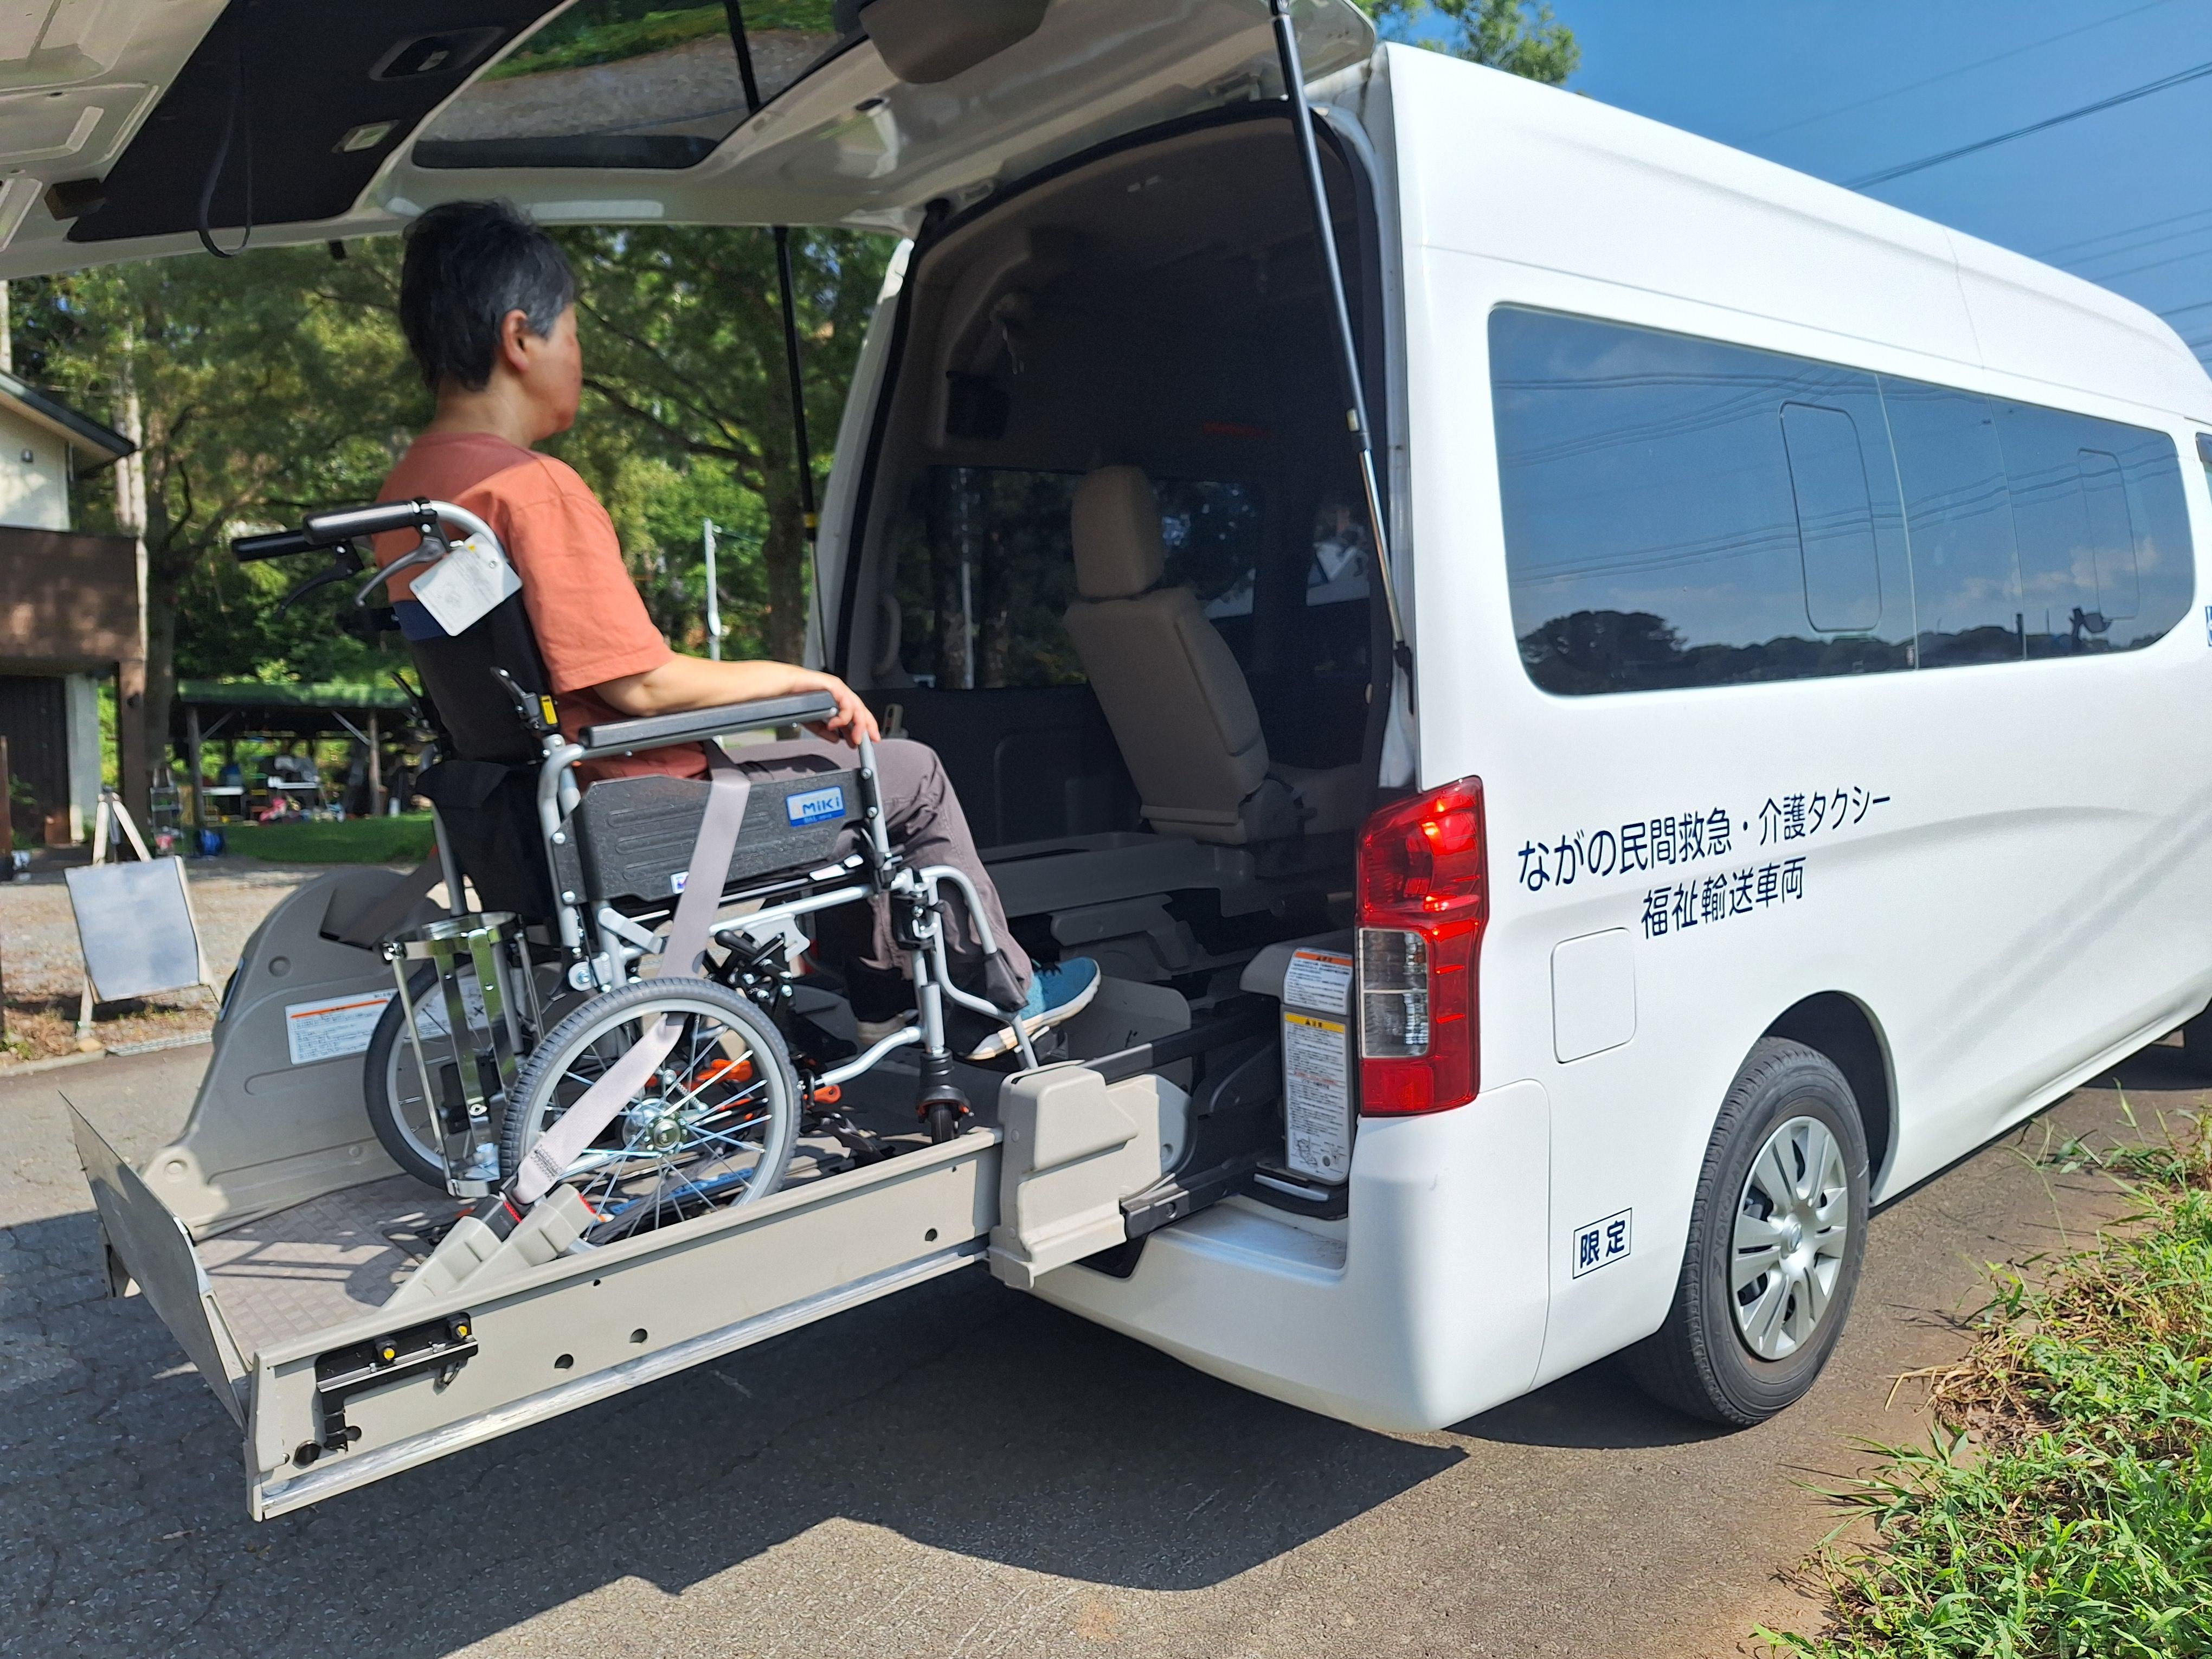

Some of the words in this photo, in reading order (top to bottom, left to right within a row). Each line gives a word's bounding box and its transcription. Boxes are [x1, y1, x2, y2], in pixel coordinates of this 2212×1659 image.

[1519, 786, 1891, 891] ながの民間救急・介護タクシー
[1641, 857, 1806, 939] 福祉輸送車両
[1580, 1220, 1625, 1269] 限定
